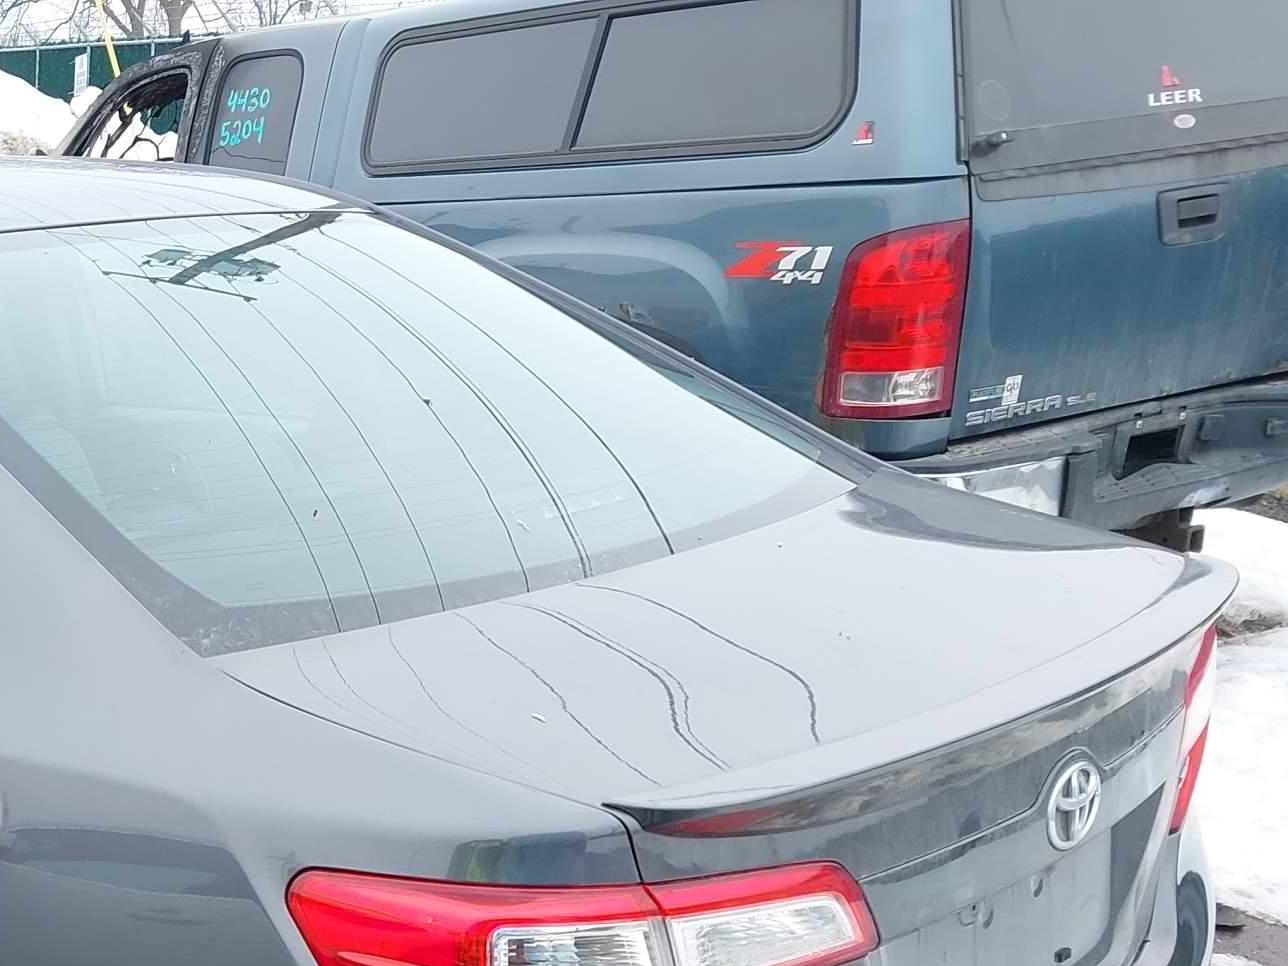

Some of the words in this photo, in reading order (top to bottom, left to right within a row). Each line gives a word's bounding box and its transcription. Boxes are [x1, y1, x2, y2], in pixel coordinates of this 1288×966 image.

[227, 87, 271, 113] 4430
[1147, 88, 1203, 107] LEER
[219, 115, 265, 146] 5204
[724, 240, 834, 278] Z71
[964, 394, 1063, 427] SIERRA
